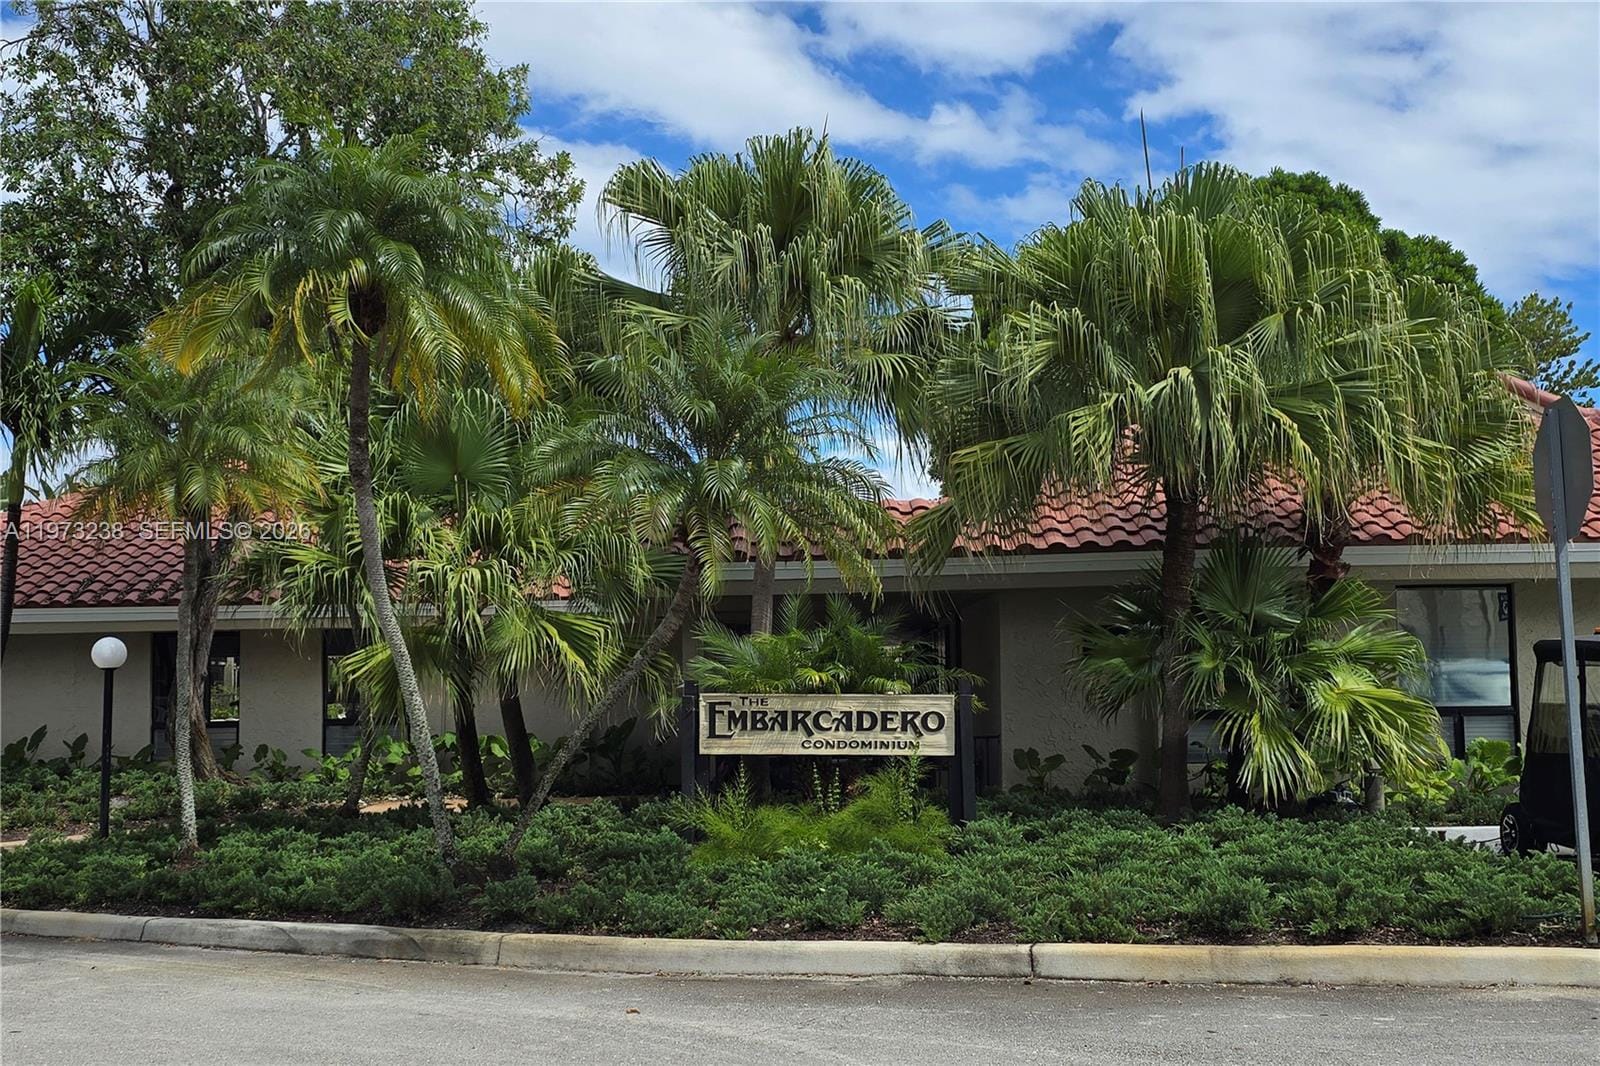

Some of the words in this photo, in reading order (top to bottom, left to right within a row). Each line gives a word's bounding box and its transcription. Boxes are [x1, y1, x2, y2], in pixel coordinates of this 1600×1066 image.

[739, 696, 769, 707] THE
[707, 701, 946, 739] EMBARCADERO
[801, 739, 920, 751] CONDOMINIUM
